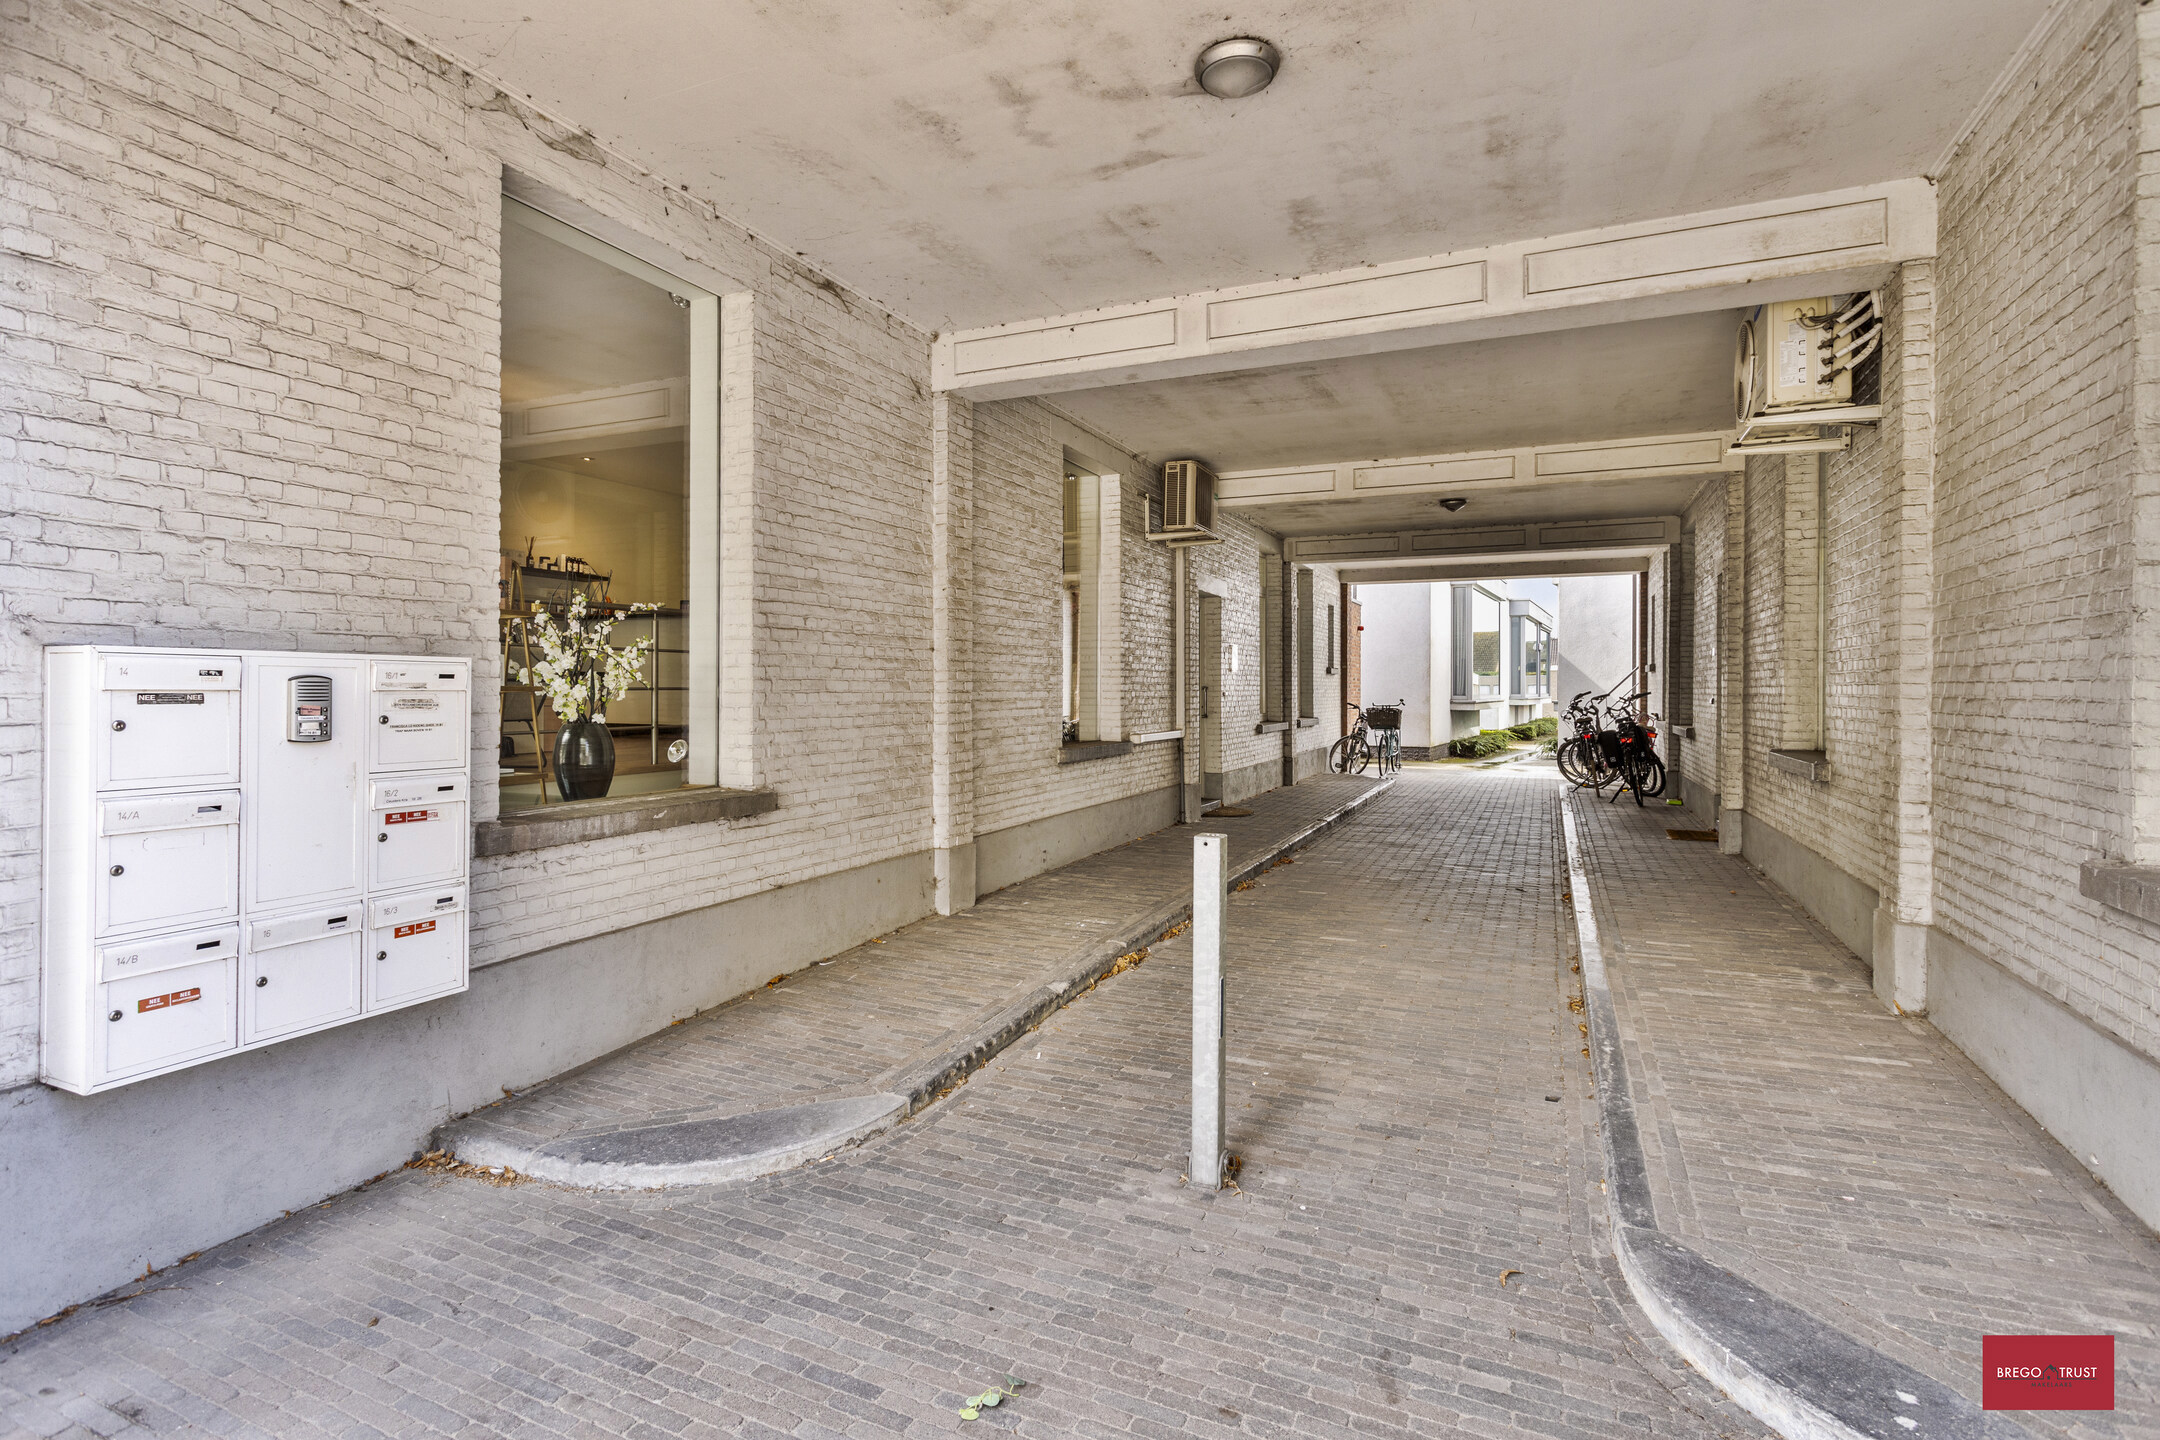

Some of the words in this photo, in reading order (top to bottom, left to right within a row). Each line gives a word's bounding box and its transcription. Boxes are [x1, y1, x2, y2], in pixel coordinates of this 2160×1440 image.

[119, 667, 129, 677] 14
[385, 789, 398, 797] 16/2
[118, 811, 140, 820] 14/A
[384, 906, 398, 915] 16/3
[263, 929, 271, 938] 16
[116, 954, 138, 966] 14/B
